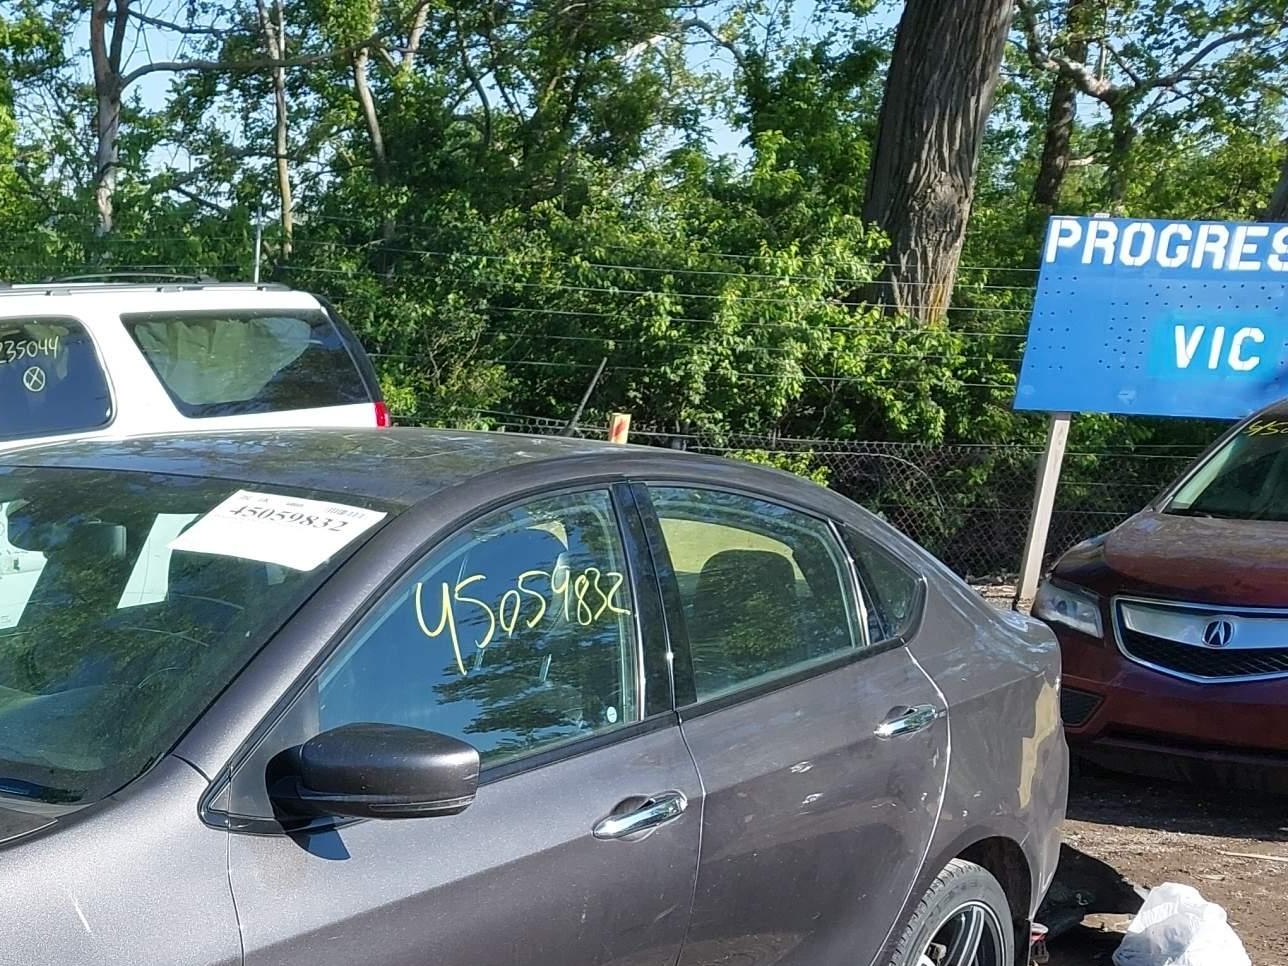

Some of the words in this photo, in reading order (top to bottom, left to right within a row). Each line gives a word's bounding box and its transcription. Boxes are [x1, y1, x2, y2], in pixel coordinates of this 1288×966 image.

[1045, 219, 1288, 272] PROGRES
[1174, 325, 1265, 371] VIC
[229, 505, 349, 532] 45059832
[415, 553, 631, 676] 45059832
